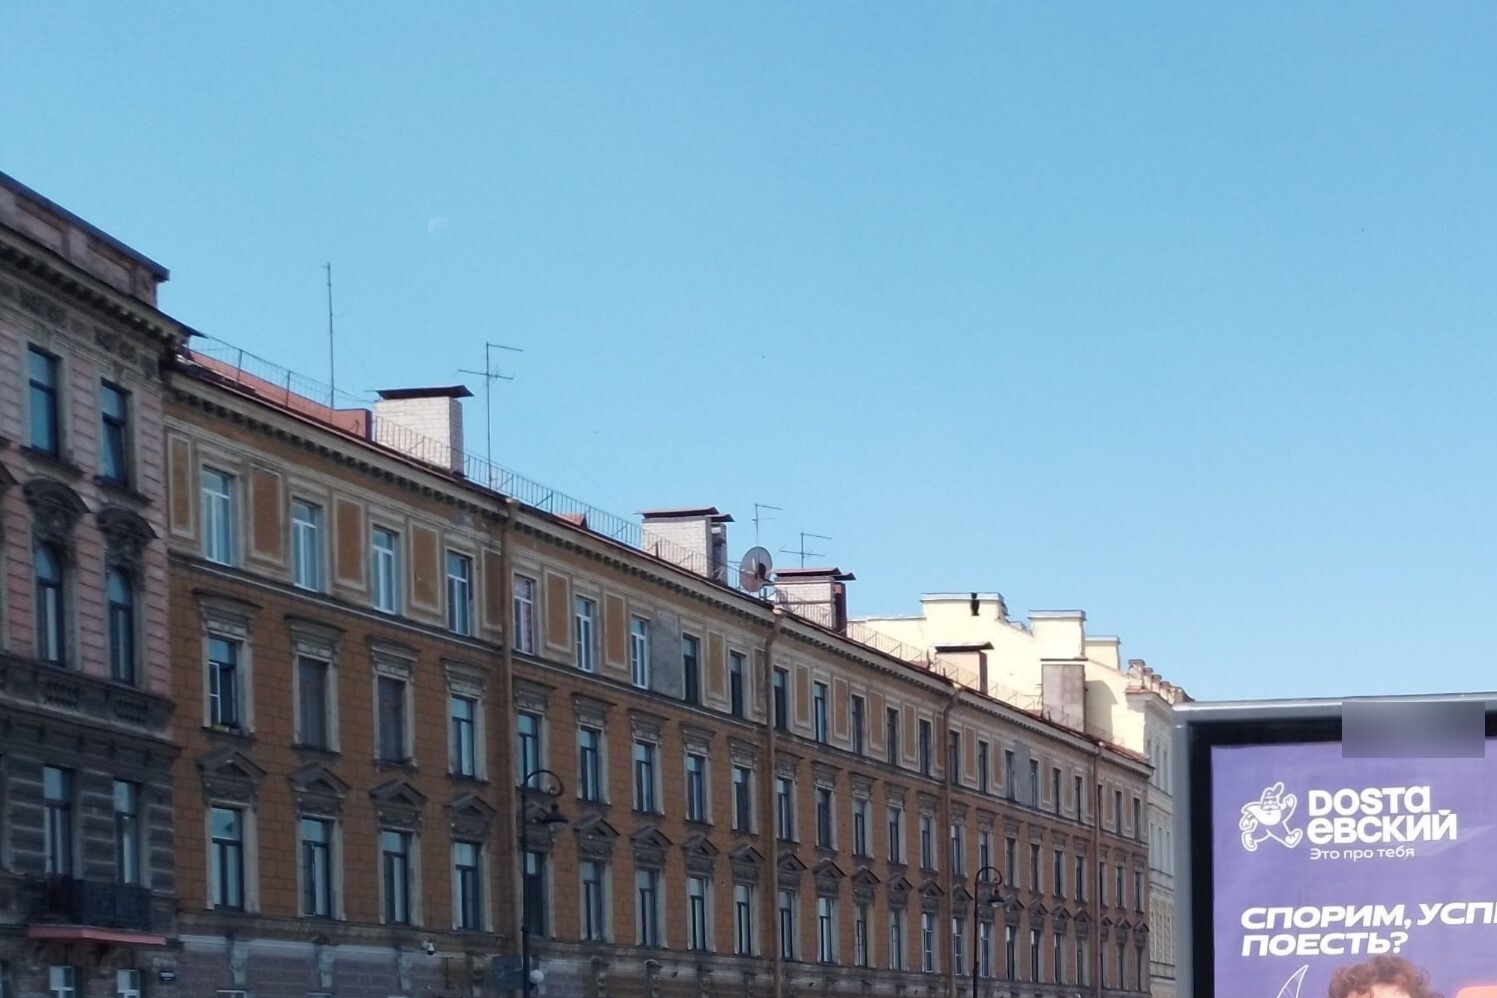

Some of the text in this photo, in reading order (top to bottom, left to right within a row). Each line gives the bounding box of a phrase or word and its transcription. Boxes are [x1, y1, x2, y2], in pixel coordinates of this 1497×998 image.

[1309, 845, 1415, 864] Это про тебя
[1240, 904, 1412, 930] СПОРИМ,
[1240, 931, 1408, 957] ПОЕСТЬ?
